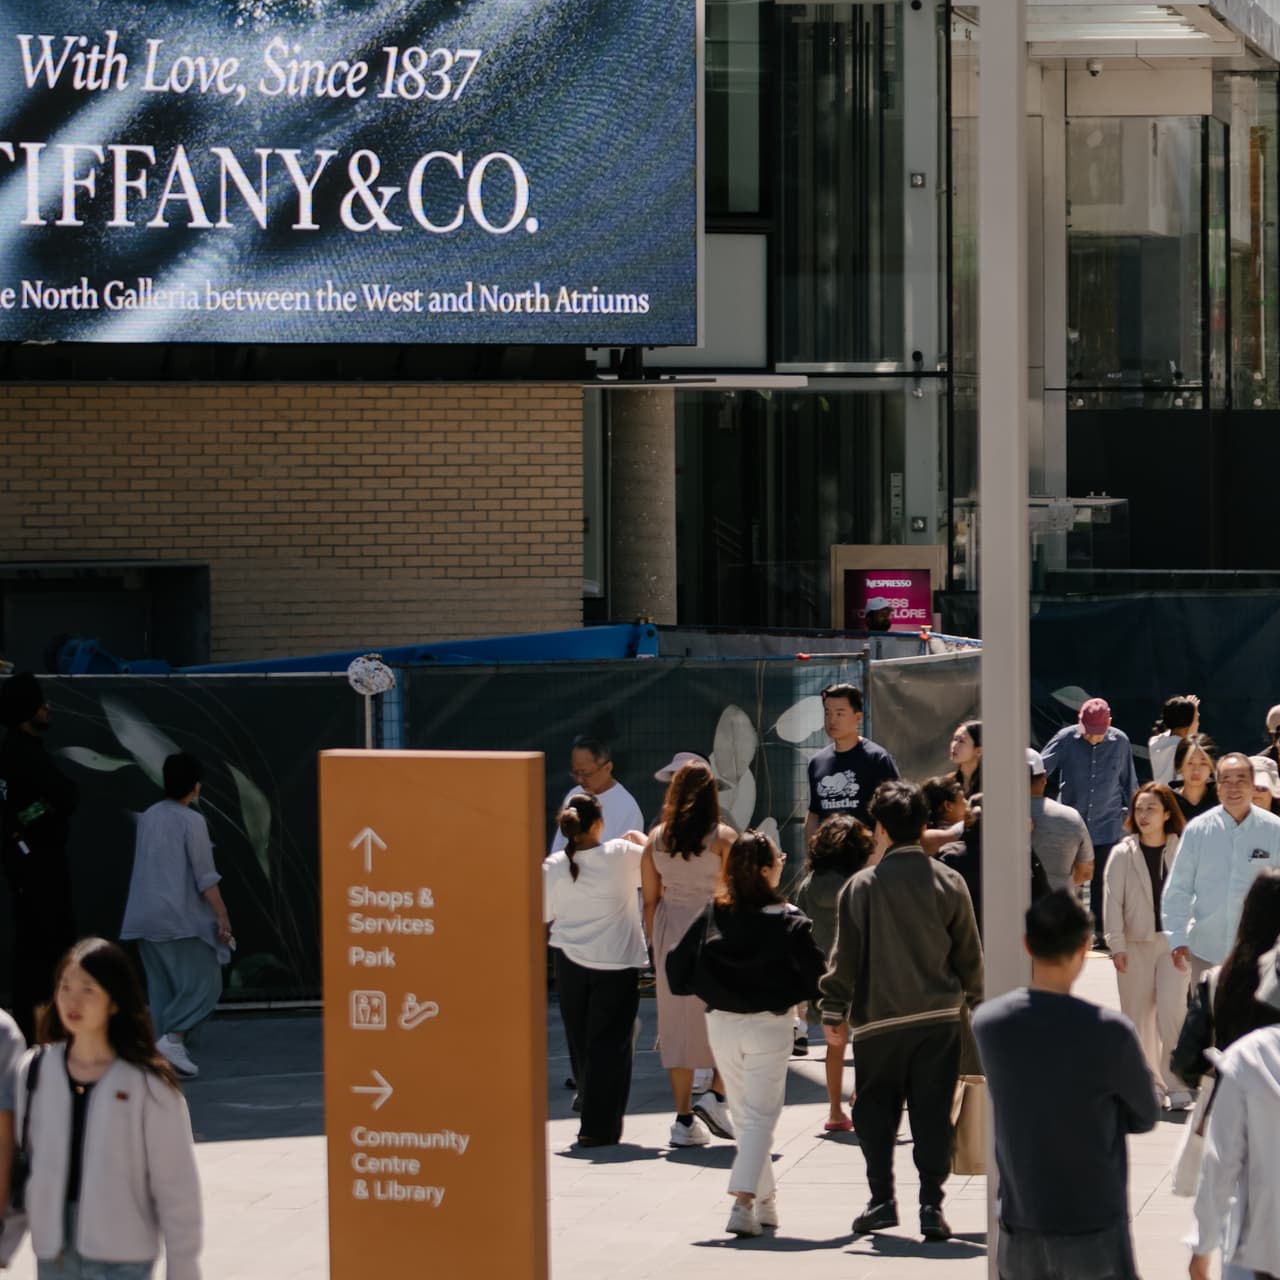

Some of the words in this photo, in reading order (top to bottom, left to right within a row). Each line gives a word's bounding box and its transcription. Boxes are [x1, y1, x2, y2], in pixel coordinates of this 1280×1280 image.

[17, 31, 128, 90] With
[141, 38, 248, 105] Love,
[259, 36, 368, 97] Since
[378, 46, 483, 101] 1837
[21, 277, 98, 311] North
[104, 280, 200, 311] Galleria
[206, 284, 311, 313] between
[316, 286, 356, 312] the
[362, 285, 422, 313] West
[429, 286, 473, 313] and
[479, 286, 550, 315] North
[555, 289, 649, 315] Atriums
[348, 887, 413, 910] Shops
[418, 887, 435, 908] &
[348, 914, 435, 935] Services
[349, 946, 395, 968] Park
[351, 1126, 470, 1154] Community
[352, 1153, 421, 1175] Centre
[353, 1180, 369, 1201] &
[374, 1179, 445, 1207] Library
